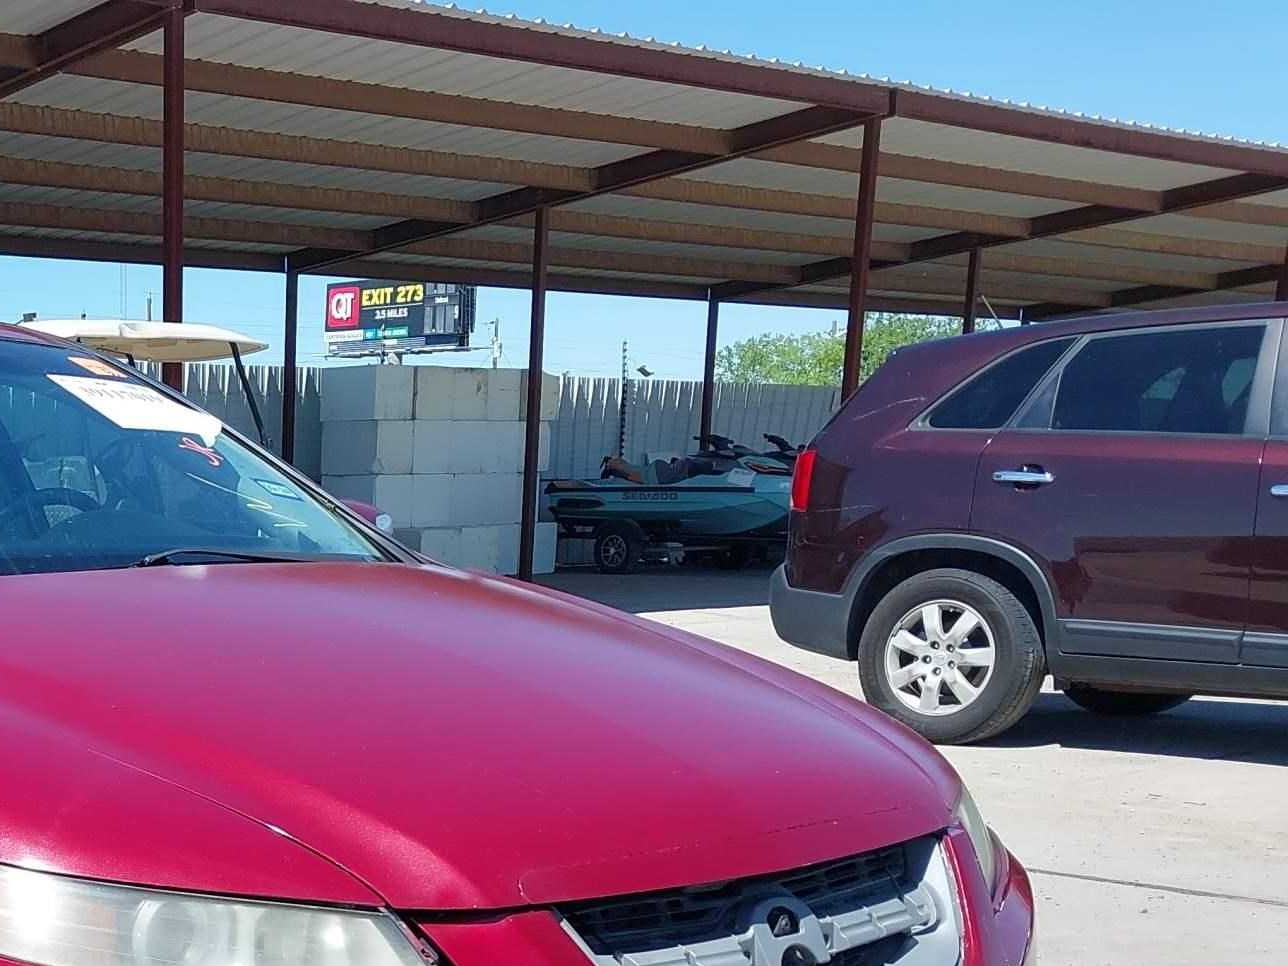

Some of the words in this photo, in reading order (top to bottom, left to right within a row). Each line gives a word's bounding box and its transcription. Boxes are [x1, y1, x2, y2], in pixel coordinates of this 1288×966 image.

[362, 287, 394, 306] EXIT
[396, 284, 424, 303] 273
[331, 293, 354, 320] QT
[387, 307, 409, 318] MILES
